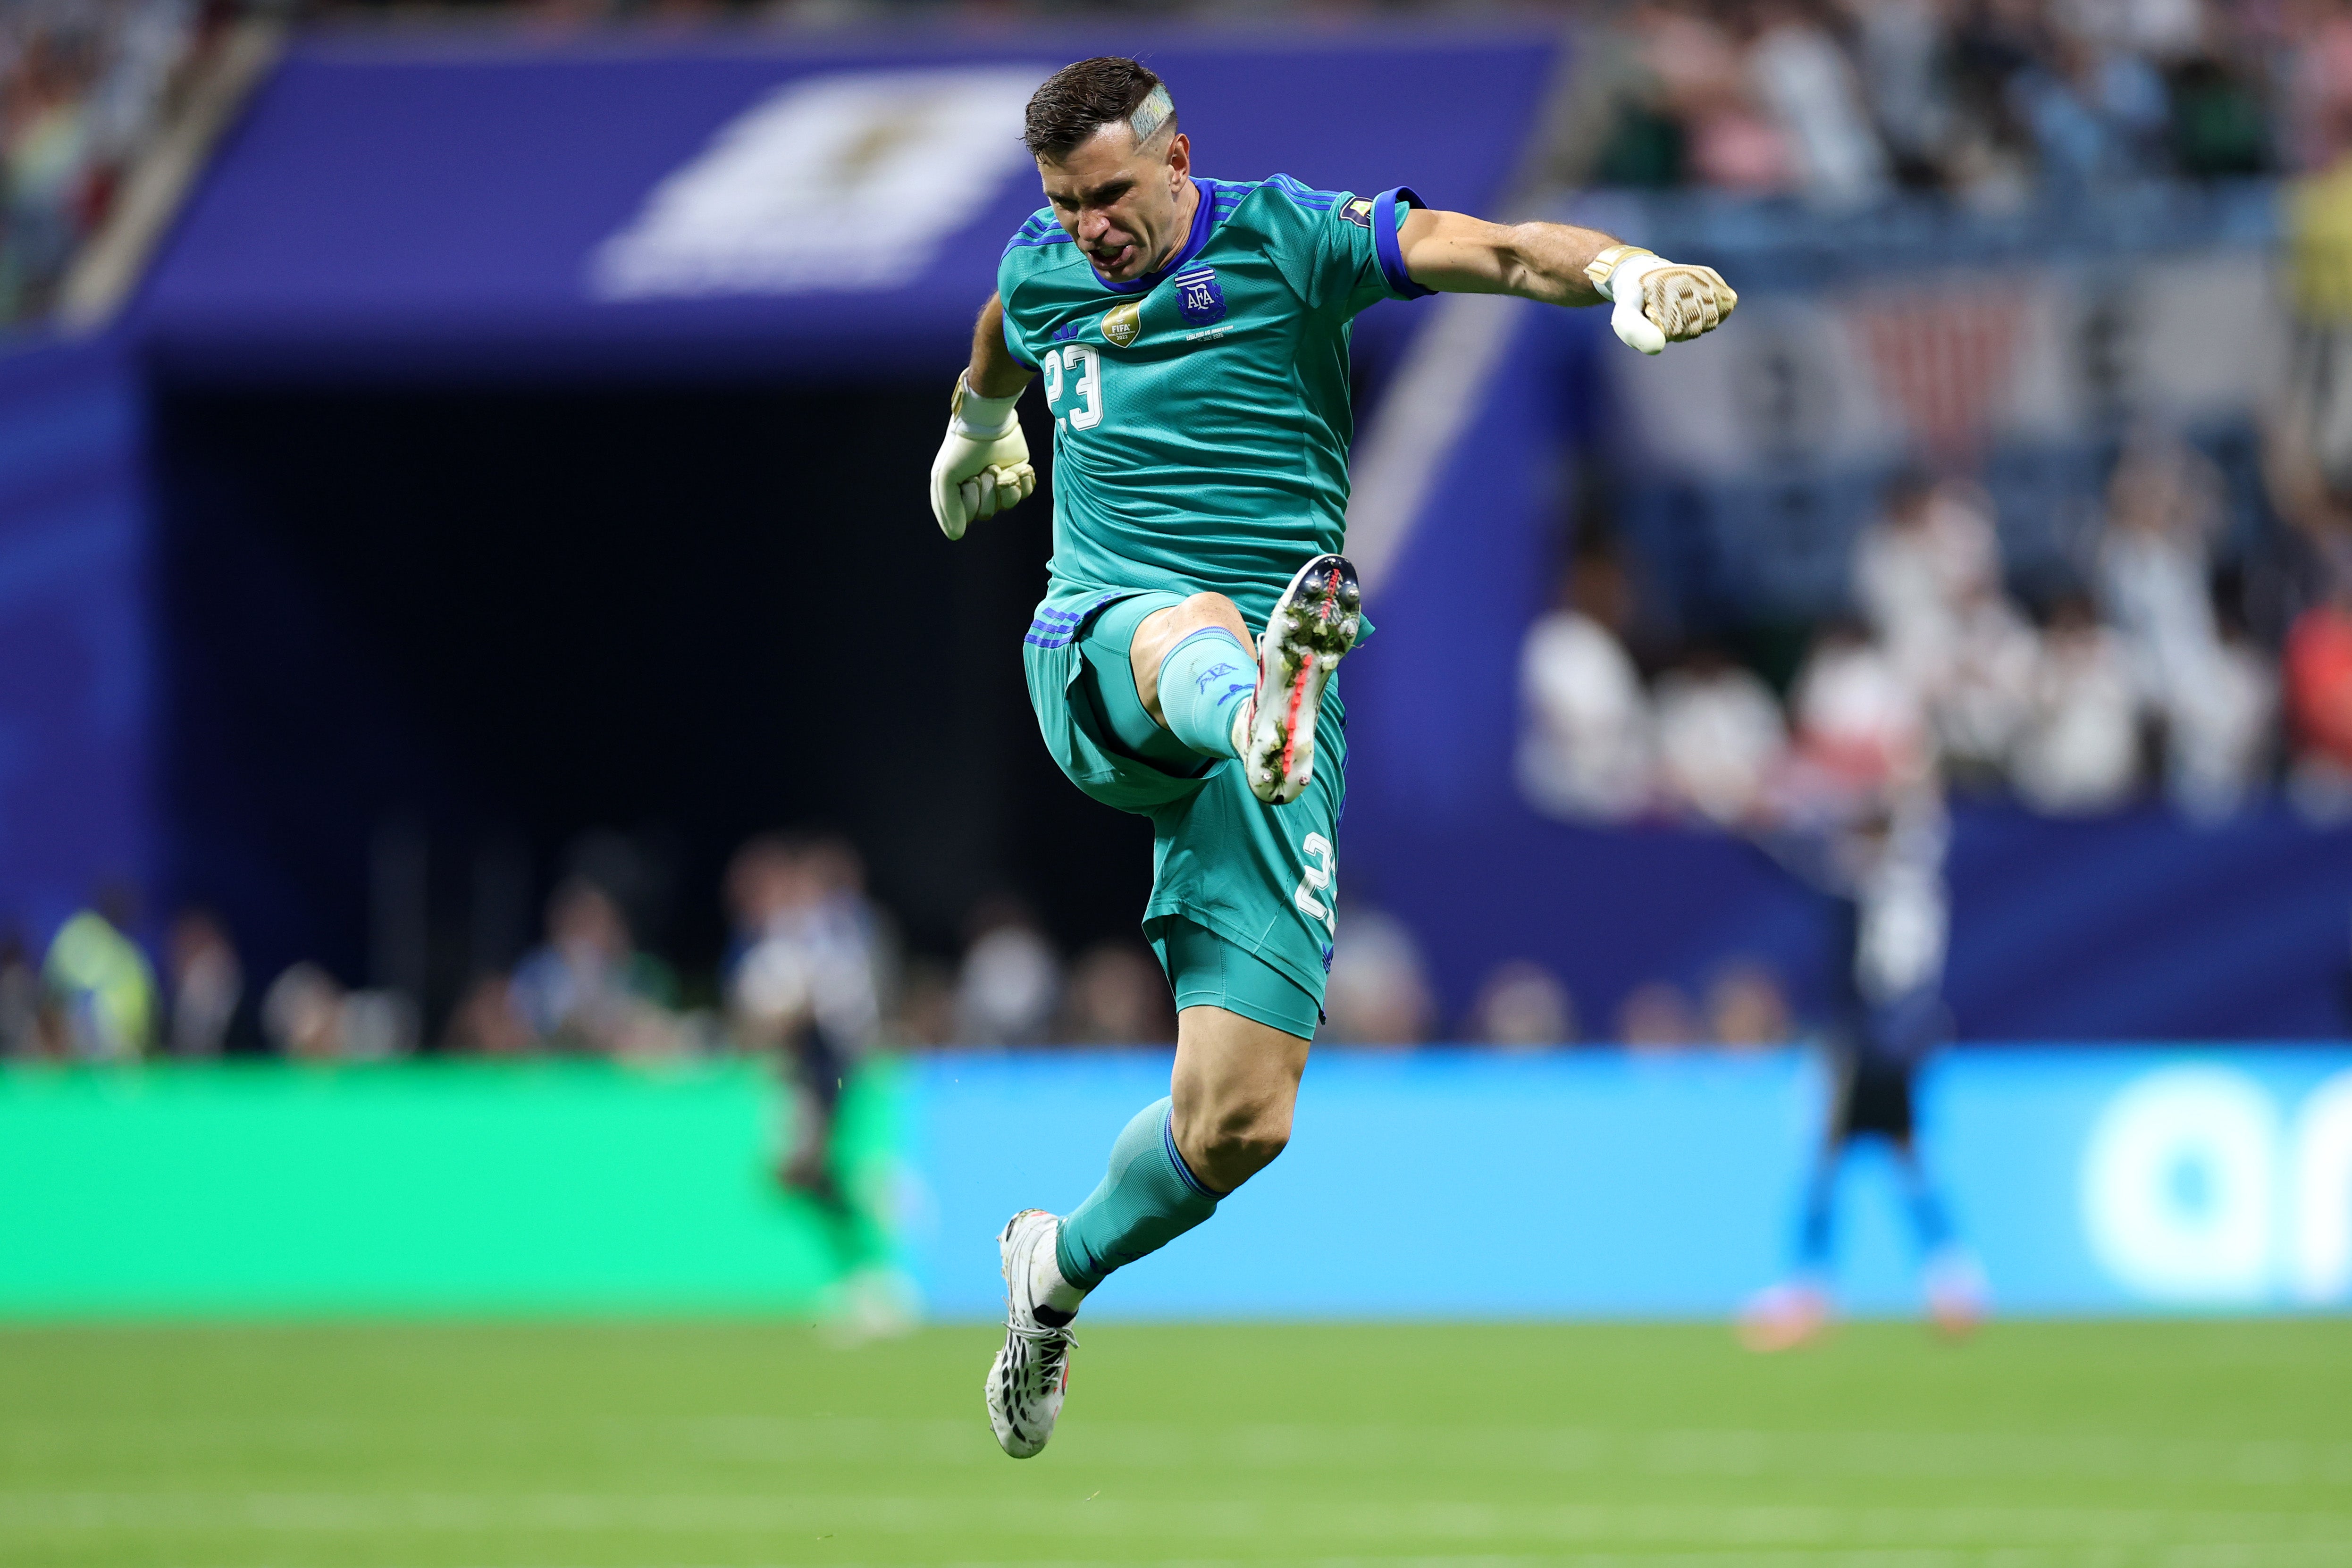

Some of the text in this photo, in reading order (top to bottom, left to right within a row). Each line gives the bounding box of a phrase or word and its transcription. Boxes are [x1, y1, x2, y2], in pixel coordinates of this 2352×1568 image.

[1186, 283, 1215, 310] AFA
[1112, 324, 1130, 333] FIFA
[1186, 332, 1204, 341] ENGLAND
[1211, 325, 1234, 334] ARGENTINA
[1045, 344, 1104, 434] 23
